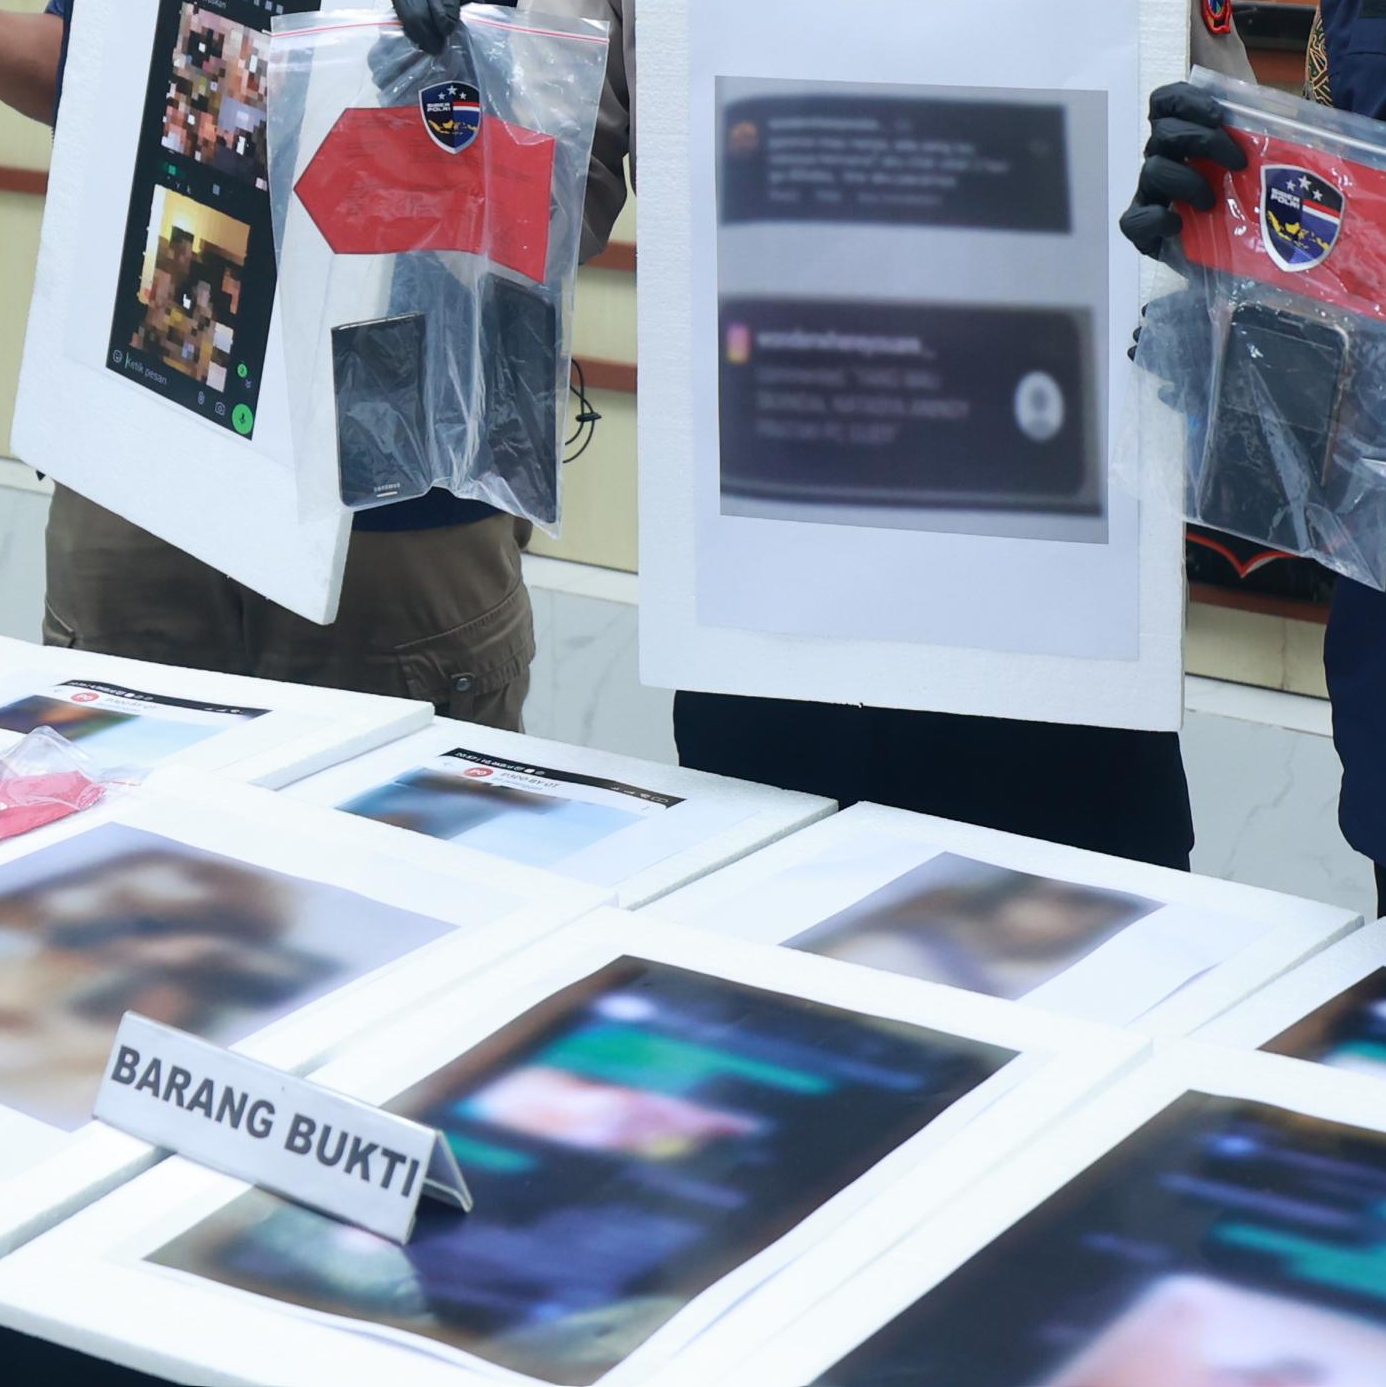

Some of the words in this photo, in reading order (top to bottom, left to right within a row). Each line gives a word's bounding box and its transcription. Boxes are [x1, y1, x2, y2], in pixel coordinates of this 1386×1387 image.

[144, 368, 168, 386] pesan
[110, 1044, 276, 1139] BARANG
[284, 1112, 420, 1199] BUKTI
